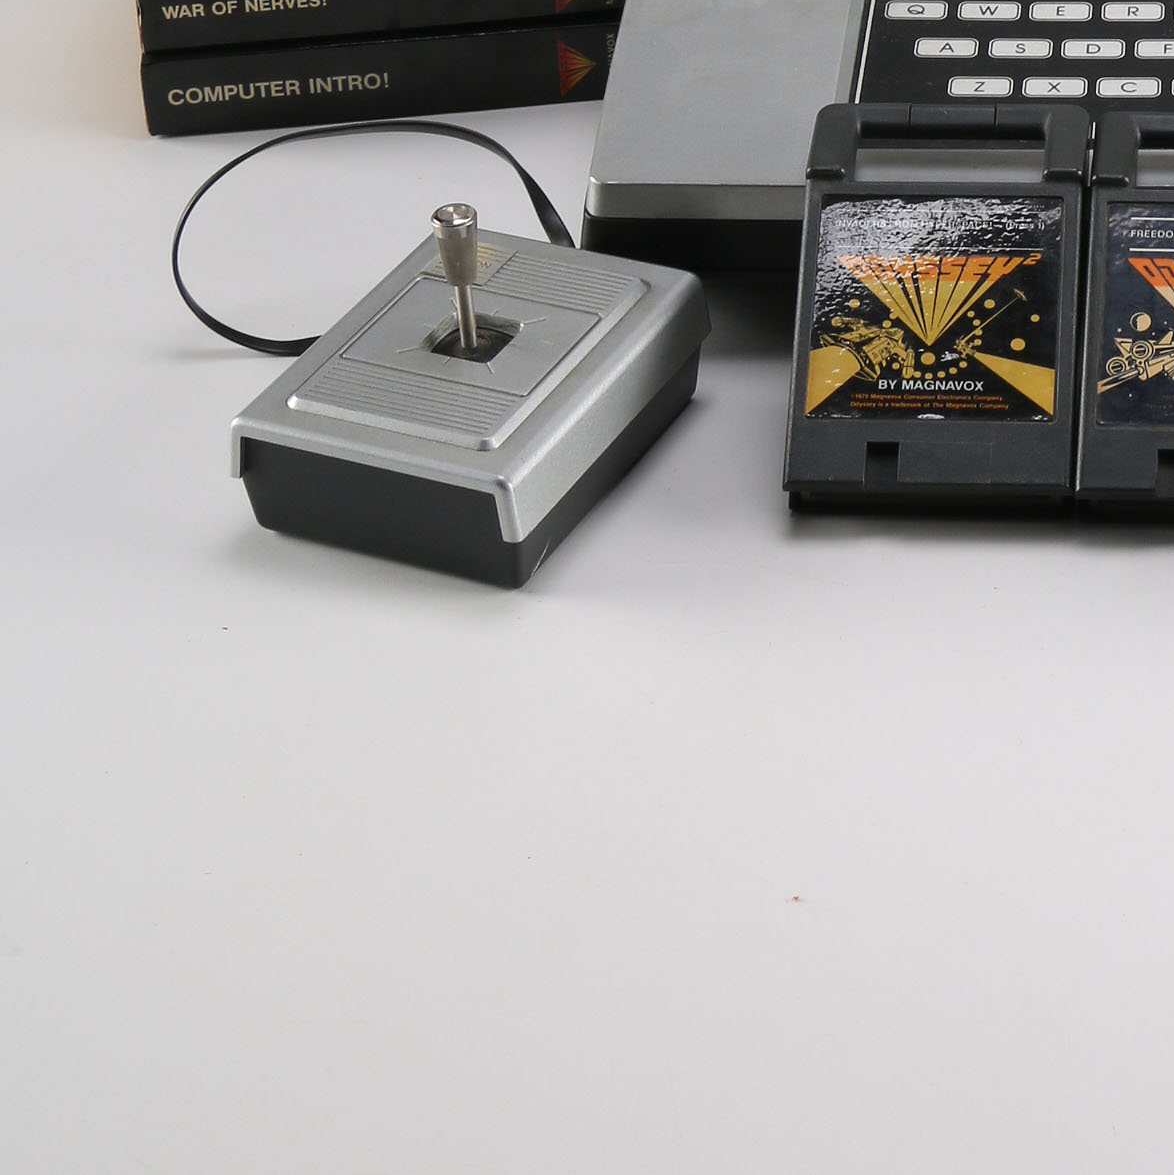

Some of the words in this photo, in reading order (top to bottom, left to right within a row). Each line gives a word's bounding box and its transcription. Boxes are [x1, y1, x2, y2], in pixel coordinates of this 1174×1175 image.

[161, 3, 205, 20] WAR
[211, 0, 238, 17] OF
[907, 4, 925, 15] Q
[978, 5, 1000, 16] W
[1056, 5, 1065, 17] E
[1127, 6, 1140, 17] R
[939, 42, 954, 53] A
[1015, 43, 1026, 54] S
[1086, 43, 1101, 55] D
[1163, 43, 1173, 54] F
[167, 79, 301, 106] COMPUTER
[309, 72, 389, 95] INTRO!
[973, 81, 986, 93] Z
[1047, 81, 1061, 93] X
[1120, 81, 1137, 93] C
[878, 379, 897, 390] BY
[901, 380, 984, 392] MAGNAVOX
